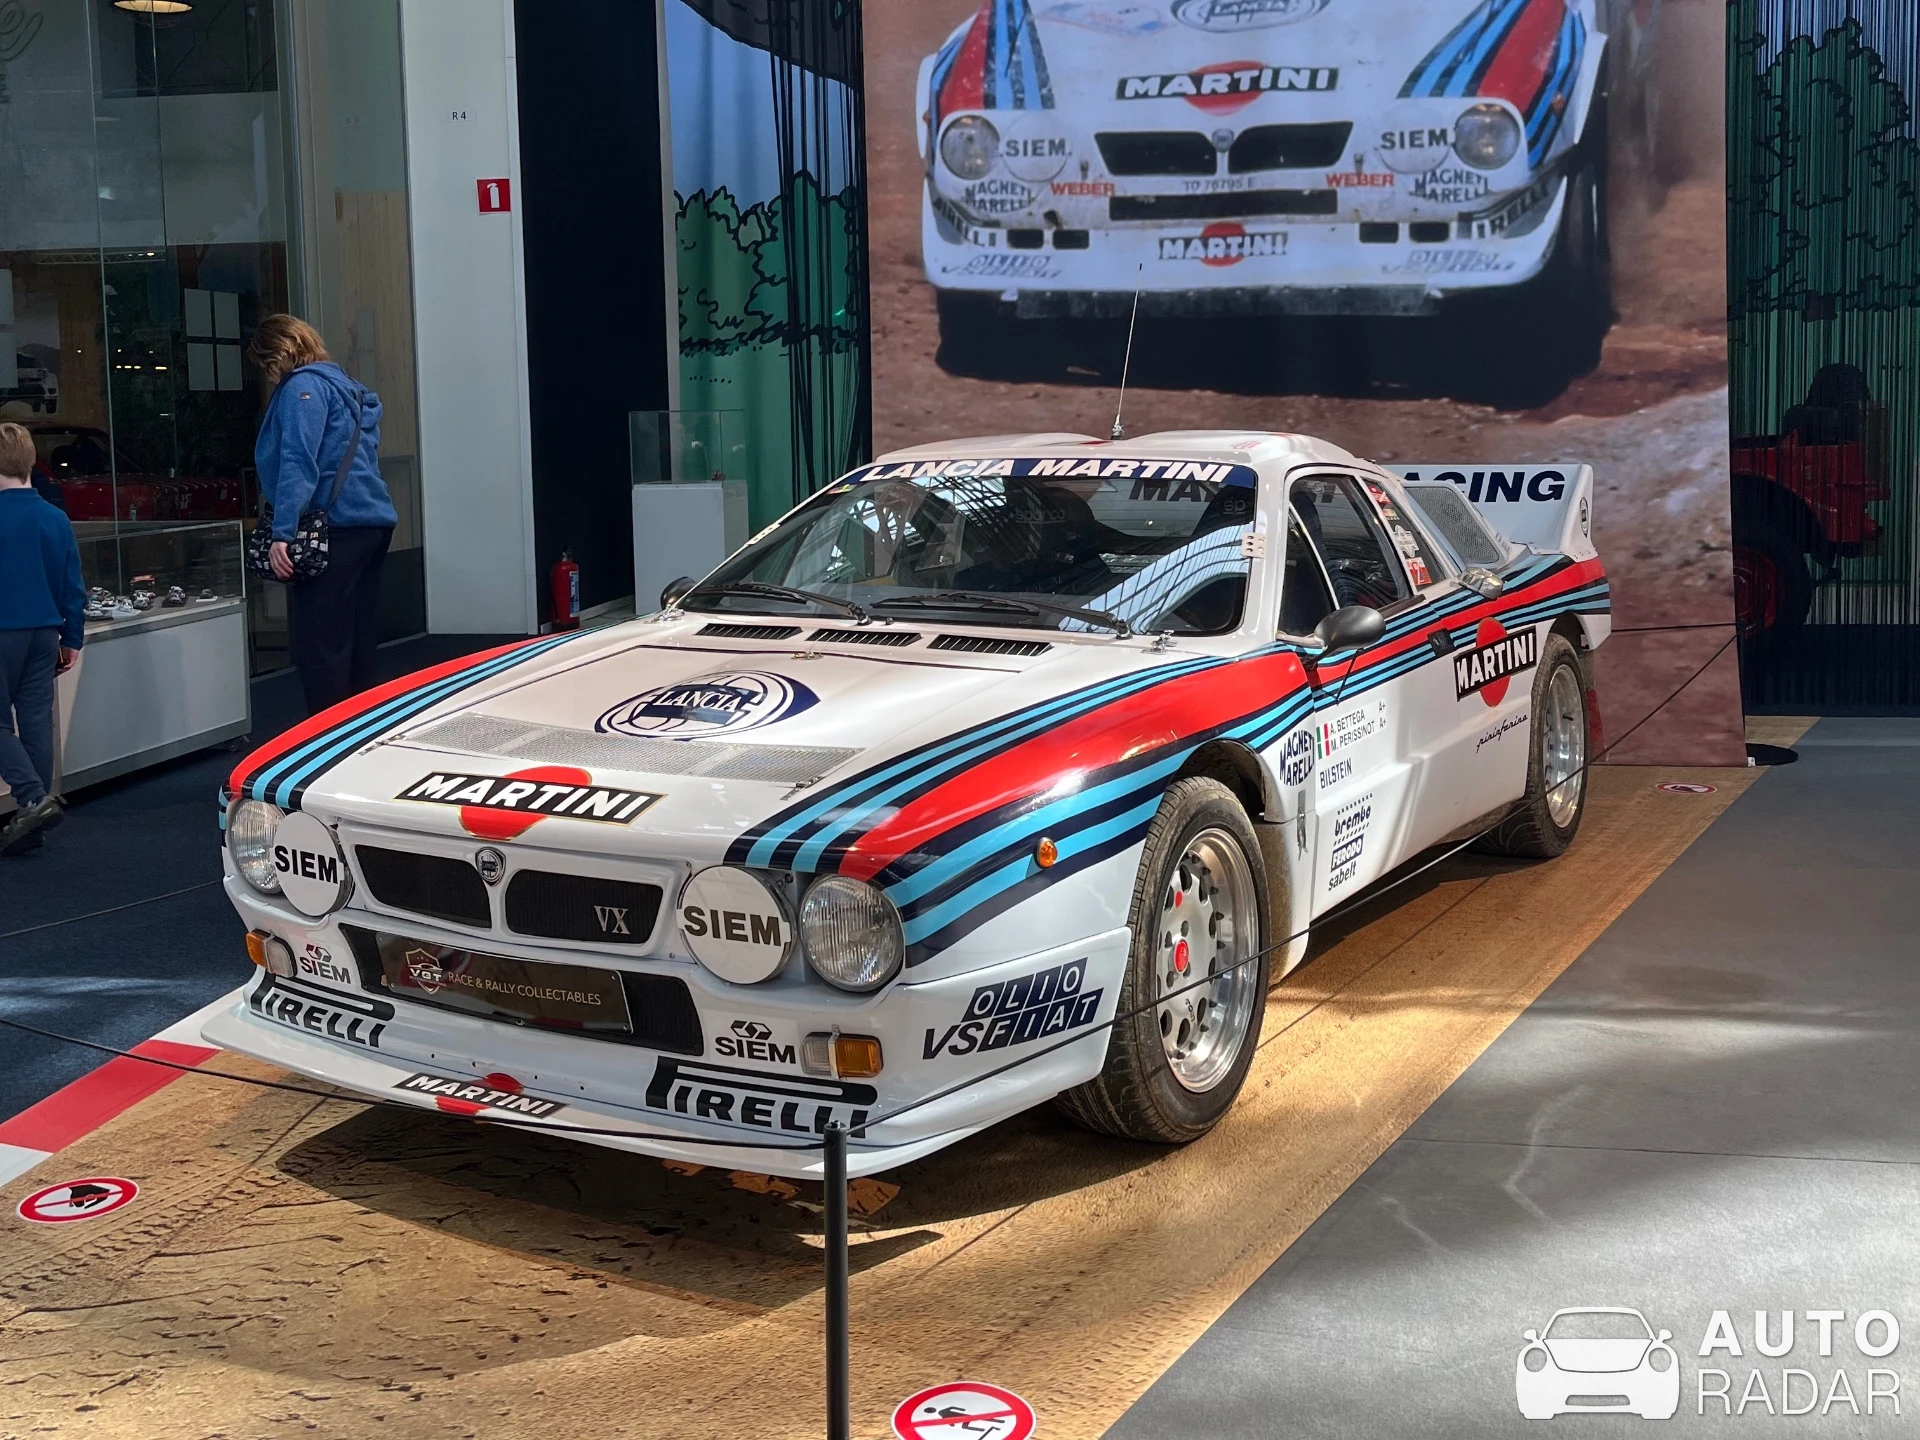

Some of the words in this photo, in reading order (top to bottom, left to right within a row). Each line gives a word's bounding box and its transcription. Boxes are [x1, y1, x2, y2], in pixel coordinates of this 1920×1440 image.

[1125, 69, 1330, 98] MARTINI
[452, 111, 459, 121] R
[460, 111, 467, 121] 4
[1005, 138, 1065, 157] SIEM
[1381, 128, 1448, 150] SIEM
[1050, 183, 1116, 197] WEBER
[1326, 173, 1395, 188] WEBER
[1160, 232, 1287, 261] MARTINI
[863, 459, 1012, 482] LANCIA
[1028, 458, 1234, 483] MARTINI
[1456, 628, 1534, 695] MARTINI
[659, 691, 743, 713] LANCIA
[1336, 709, 1366, 732] BETTEGA
[1339, 720, 1376, 748] PERISSINOT
[1279, 730, 1314, 768] MAGNETI
[1319, 758, 1353, 790] BILSTEIN
[405, 774, 650, 821] MARTINI
[1334, 805, 1371, 837] brembo
[274, 845, 339, 885] SIEM
[1331, 837, 1363, 870] FERODO
[1328, 860, 1357, 892] sabelt
[593, 905, 631, 935] VX
[683, 905, 782, 947] SIEM
[299, 955, 351, 984] SIEM
[448, 971, 474, 988] RACE
[475, 977, 483, 989] &
[485, 979, 516, 995] RALLY
[517, 984, 602, 1006] COLLECTABLES
[964, 961, 1086, 1020] OLIO
[250, 973, 396, 1049] PIRELLI
[714, 1035, 797, 1065] SIEM
[404, 1074, 553, 1117] MARTINI
